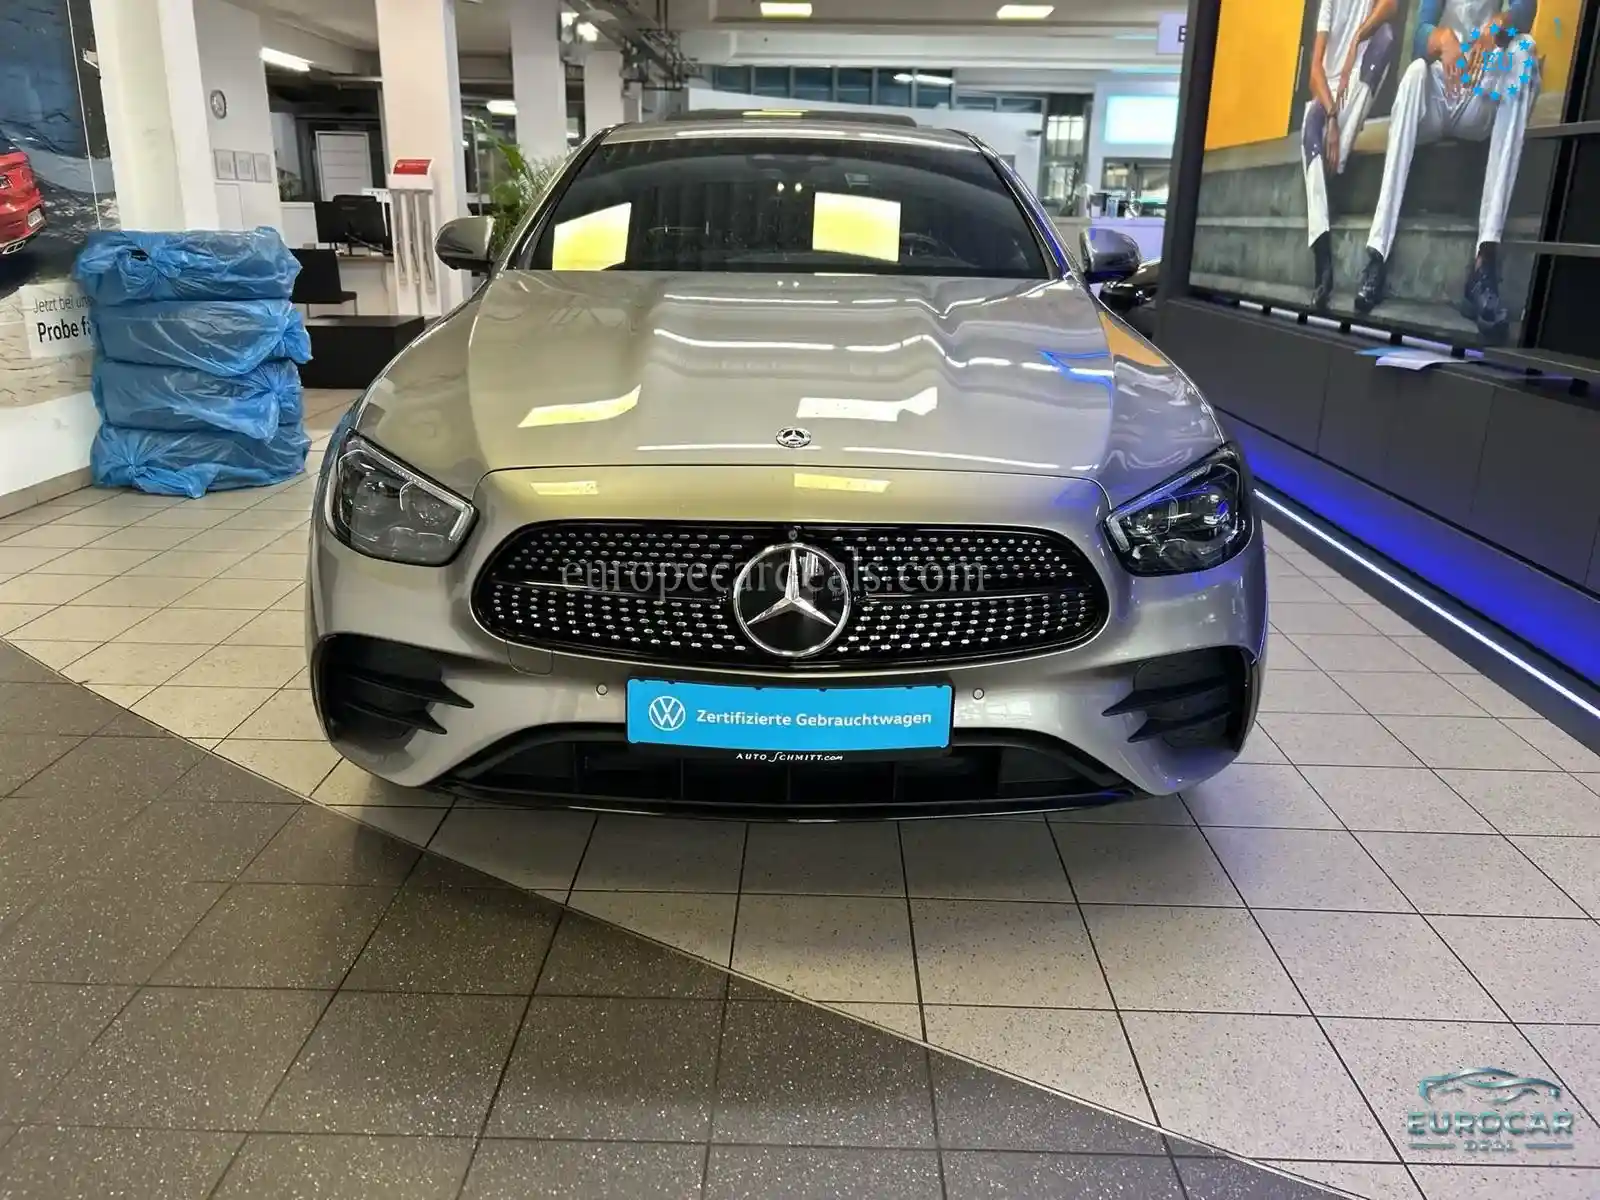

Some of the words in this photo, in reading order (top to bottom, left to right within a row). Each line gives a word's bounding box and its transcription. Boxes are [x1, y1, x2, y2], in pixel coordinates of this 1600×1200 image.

[33, 297, 57, 314] Jetzt
[59, 295, 73, 310] bei
[36, 318, 79, 343] Probe
[696, 709, 792, 727] Zertifizierte
[795, 712, 932, 728] Gebrauchtwagen
[735, 752, 767, 761] AUTO
